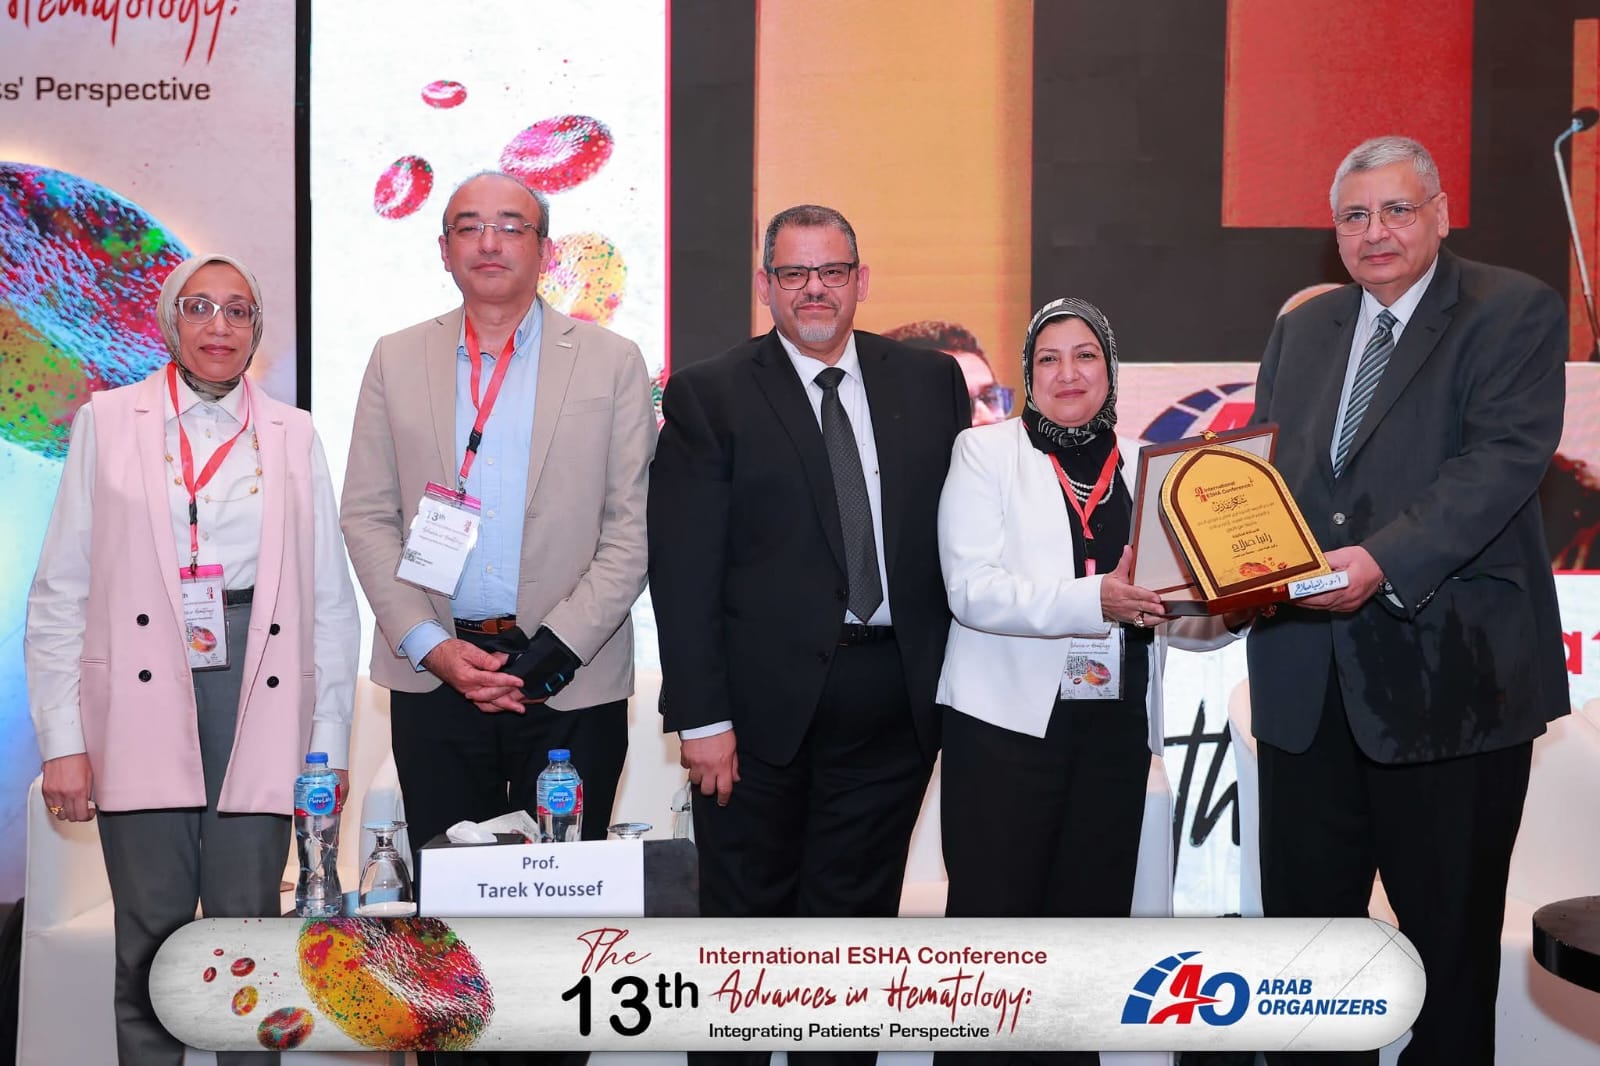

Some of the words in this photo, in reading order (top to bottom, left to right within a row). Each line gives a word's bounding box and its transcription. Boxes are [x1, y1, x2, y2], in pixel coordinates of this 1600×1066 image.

[35, 76, 211, 107] Perspective
[522, 856, 560, 870] Prof.
[477, 881, 528, 898] Tarek
[533, 880, 604, 897] Youssef
